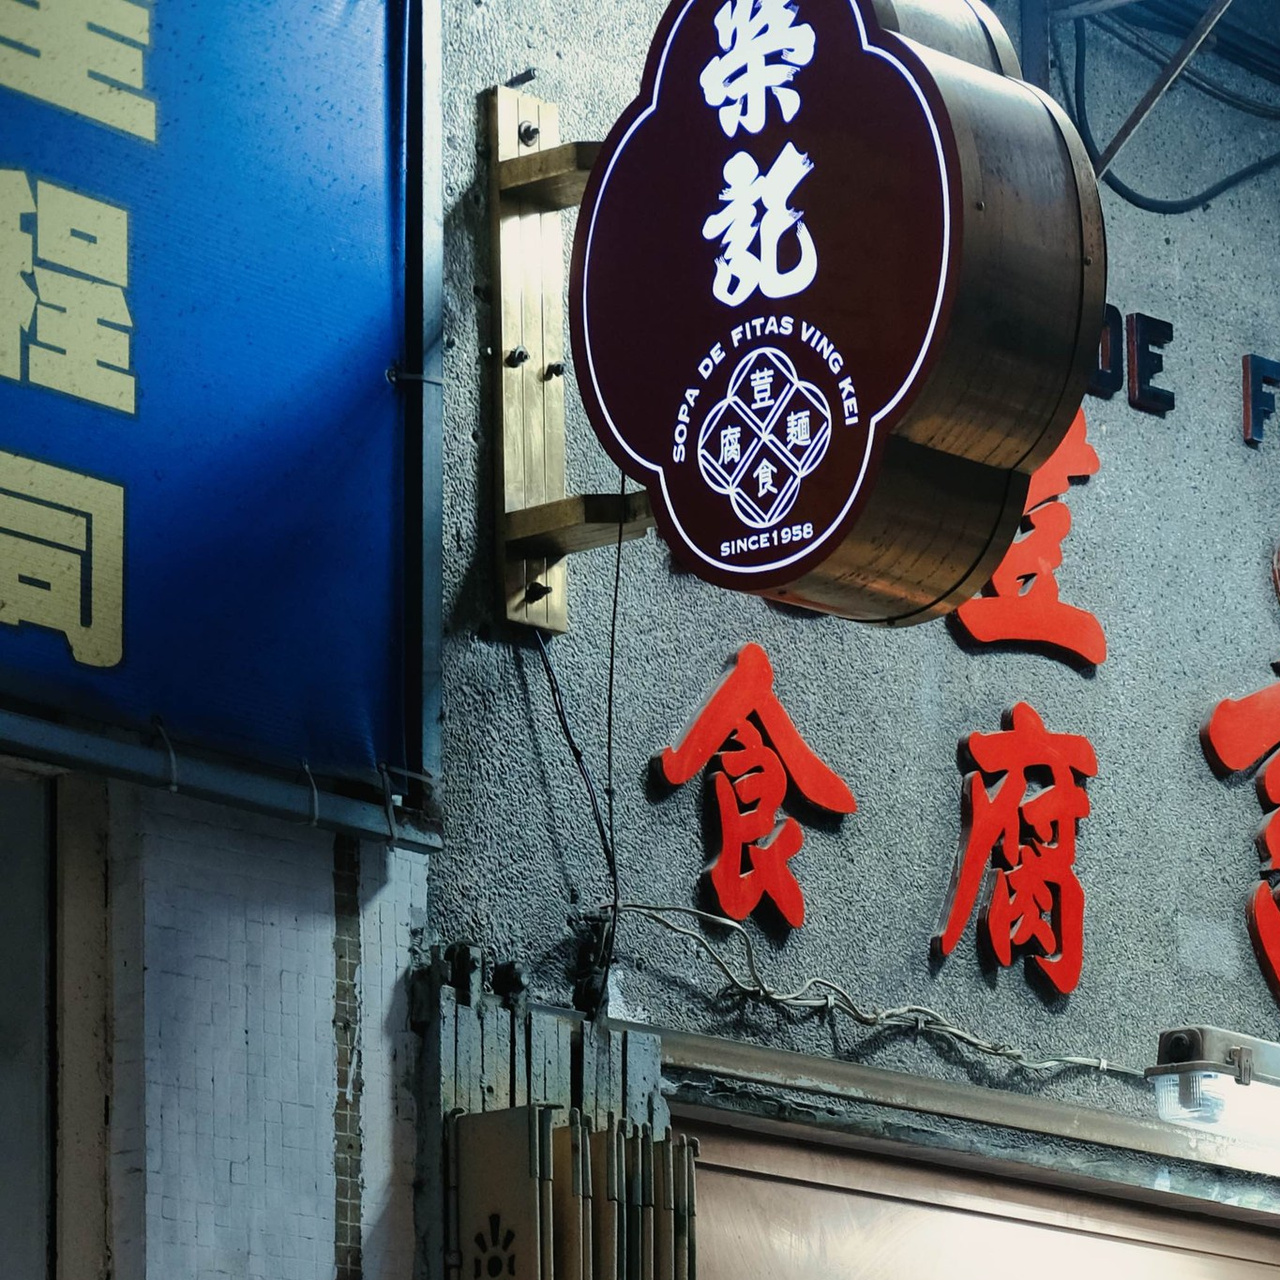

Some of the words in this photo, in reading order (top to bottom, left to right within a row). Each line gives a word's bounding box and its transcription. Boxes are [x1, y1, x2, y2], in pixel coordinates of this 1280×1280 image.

[700, 0, 818, 307] 榮記
[673, 387, 701, 464] SOPA
[698, 341, 725, 381] DE
[730, 315, 796, 345] FITAS
[800, 321, 846, 376] VING
[838, 373, 859, 427] KEI
[1088, 303, 1175, 417] DE
[652, 643, 858, 929] 食
